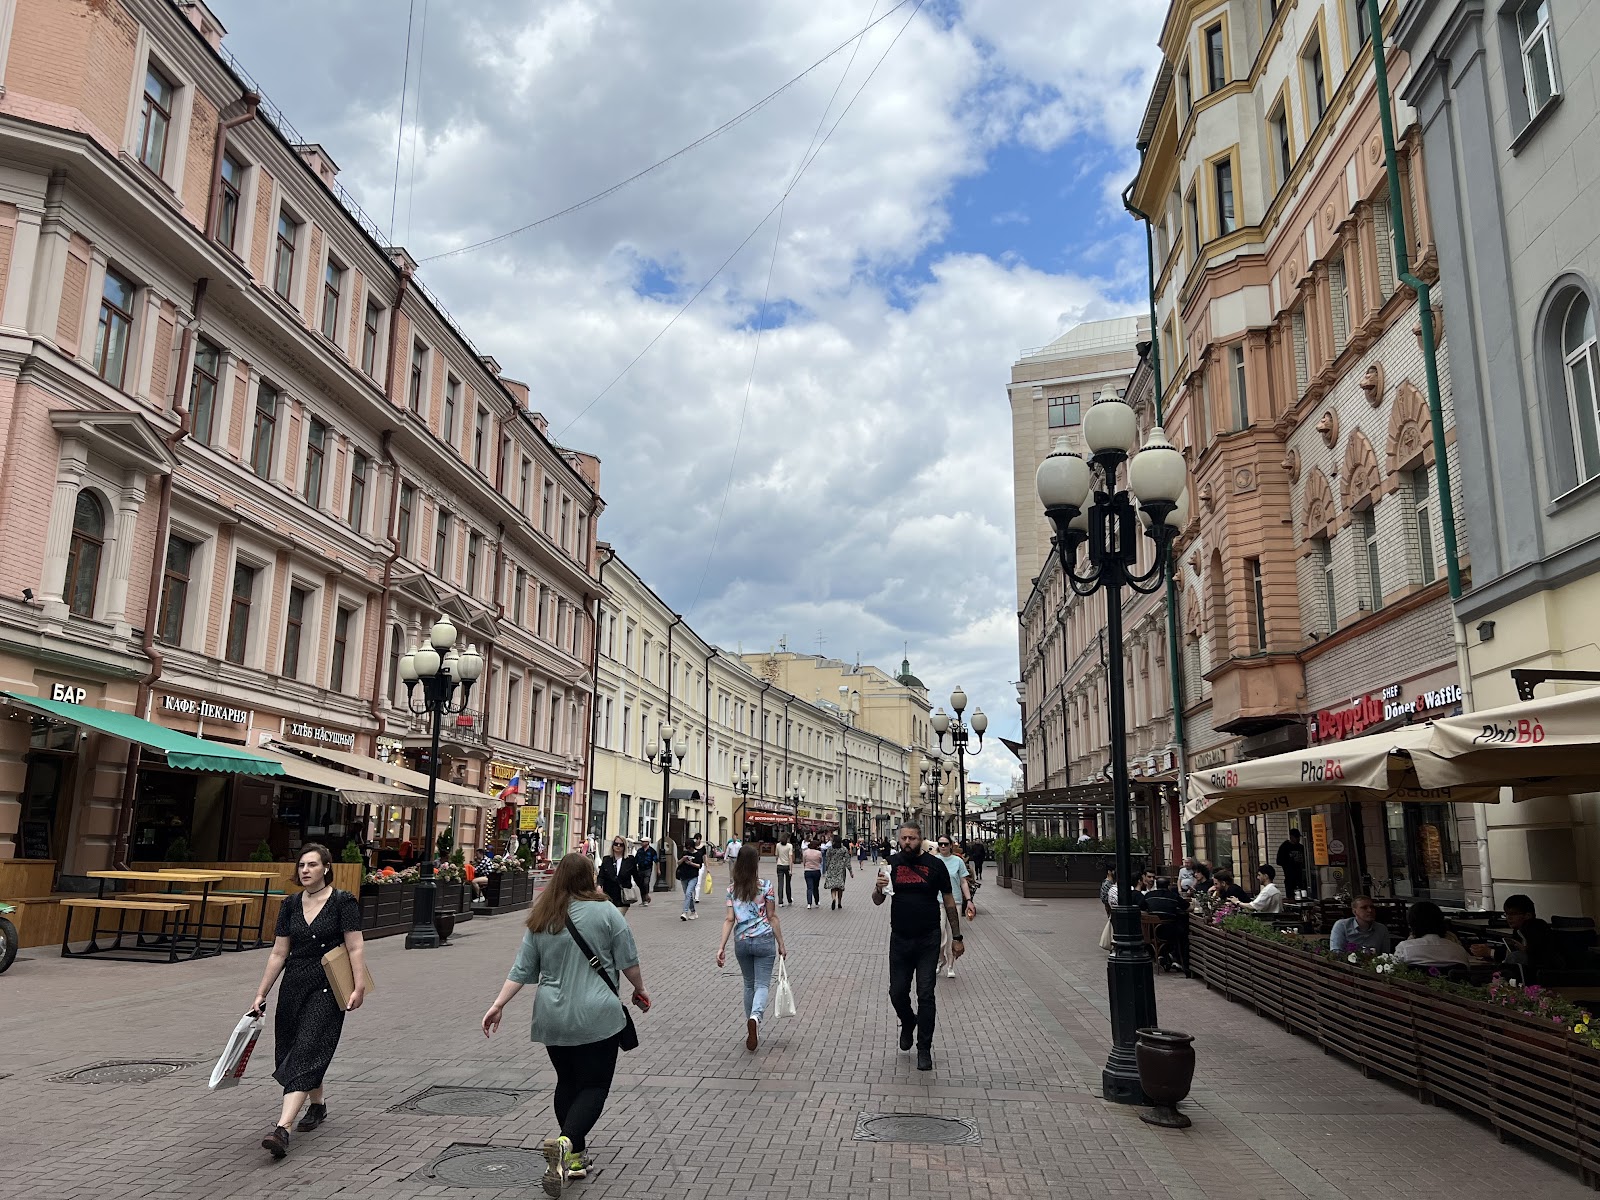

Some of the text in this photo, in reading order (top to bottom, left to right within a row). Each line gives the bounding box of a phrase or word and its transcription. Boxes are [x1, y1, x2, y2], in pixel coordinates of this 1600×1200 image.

[53, 683, 87, 704] БАР
[1382, 685, 1399, 701] SHEF
[1384, 685, 1462, 721] Döner & Waffle
[314, 727, 355, 746] НАСУЩНЫЙ
